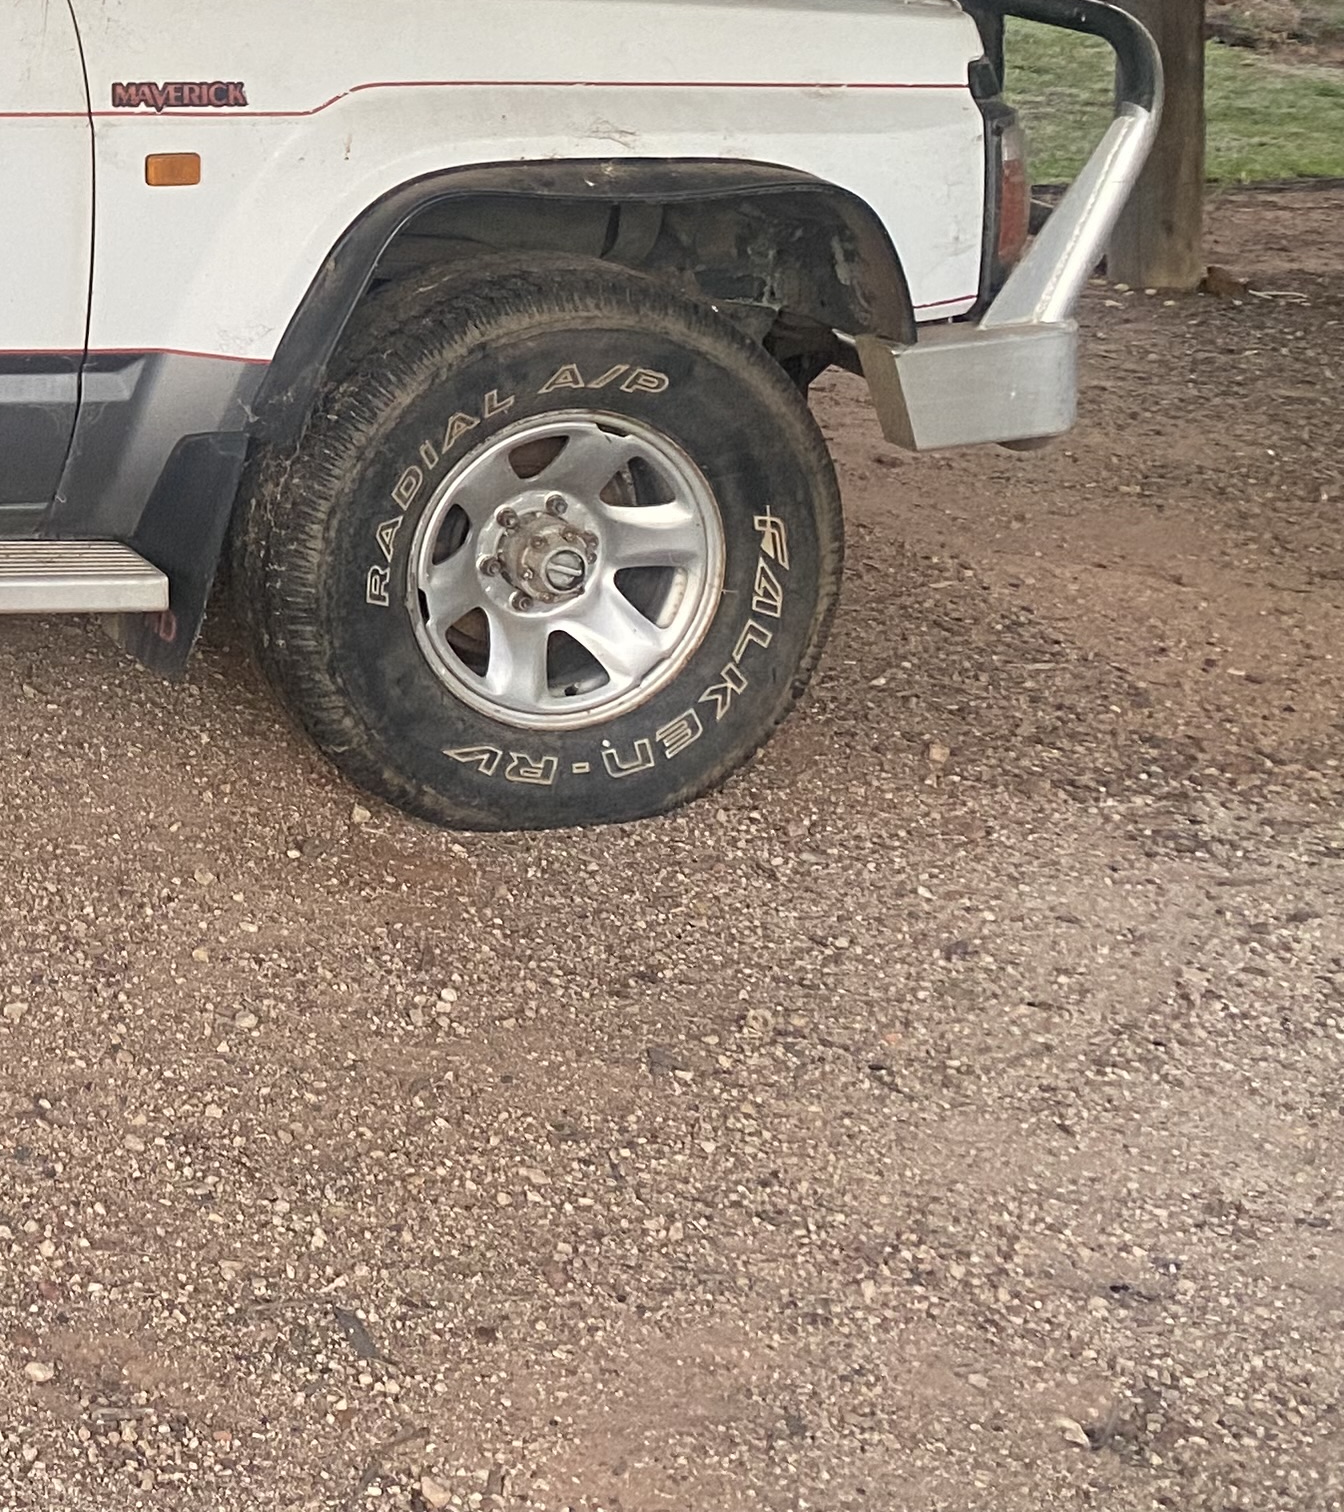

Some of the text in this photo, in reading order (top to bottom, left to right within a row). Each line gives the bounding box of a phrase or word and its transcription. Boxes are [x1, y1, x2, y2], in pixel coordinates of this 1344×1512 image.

[111, 80, 249, 113] MAVERICK
[366, 363, 670, 607] RADIAL A/P
